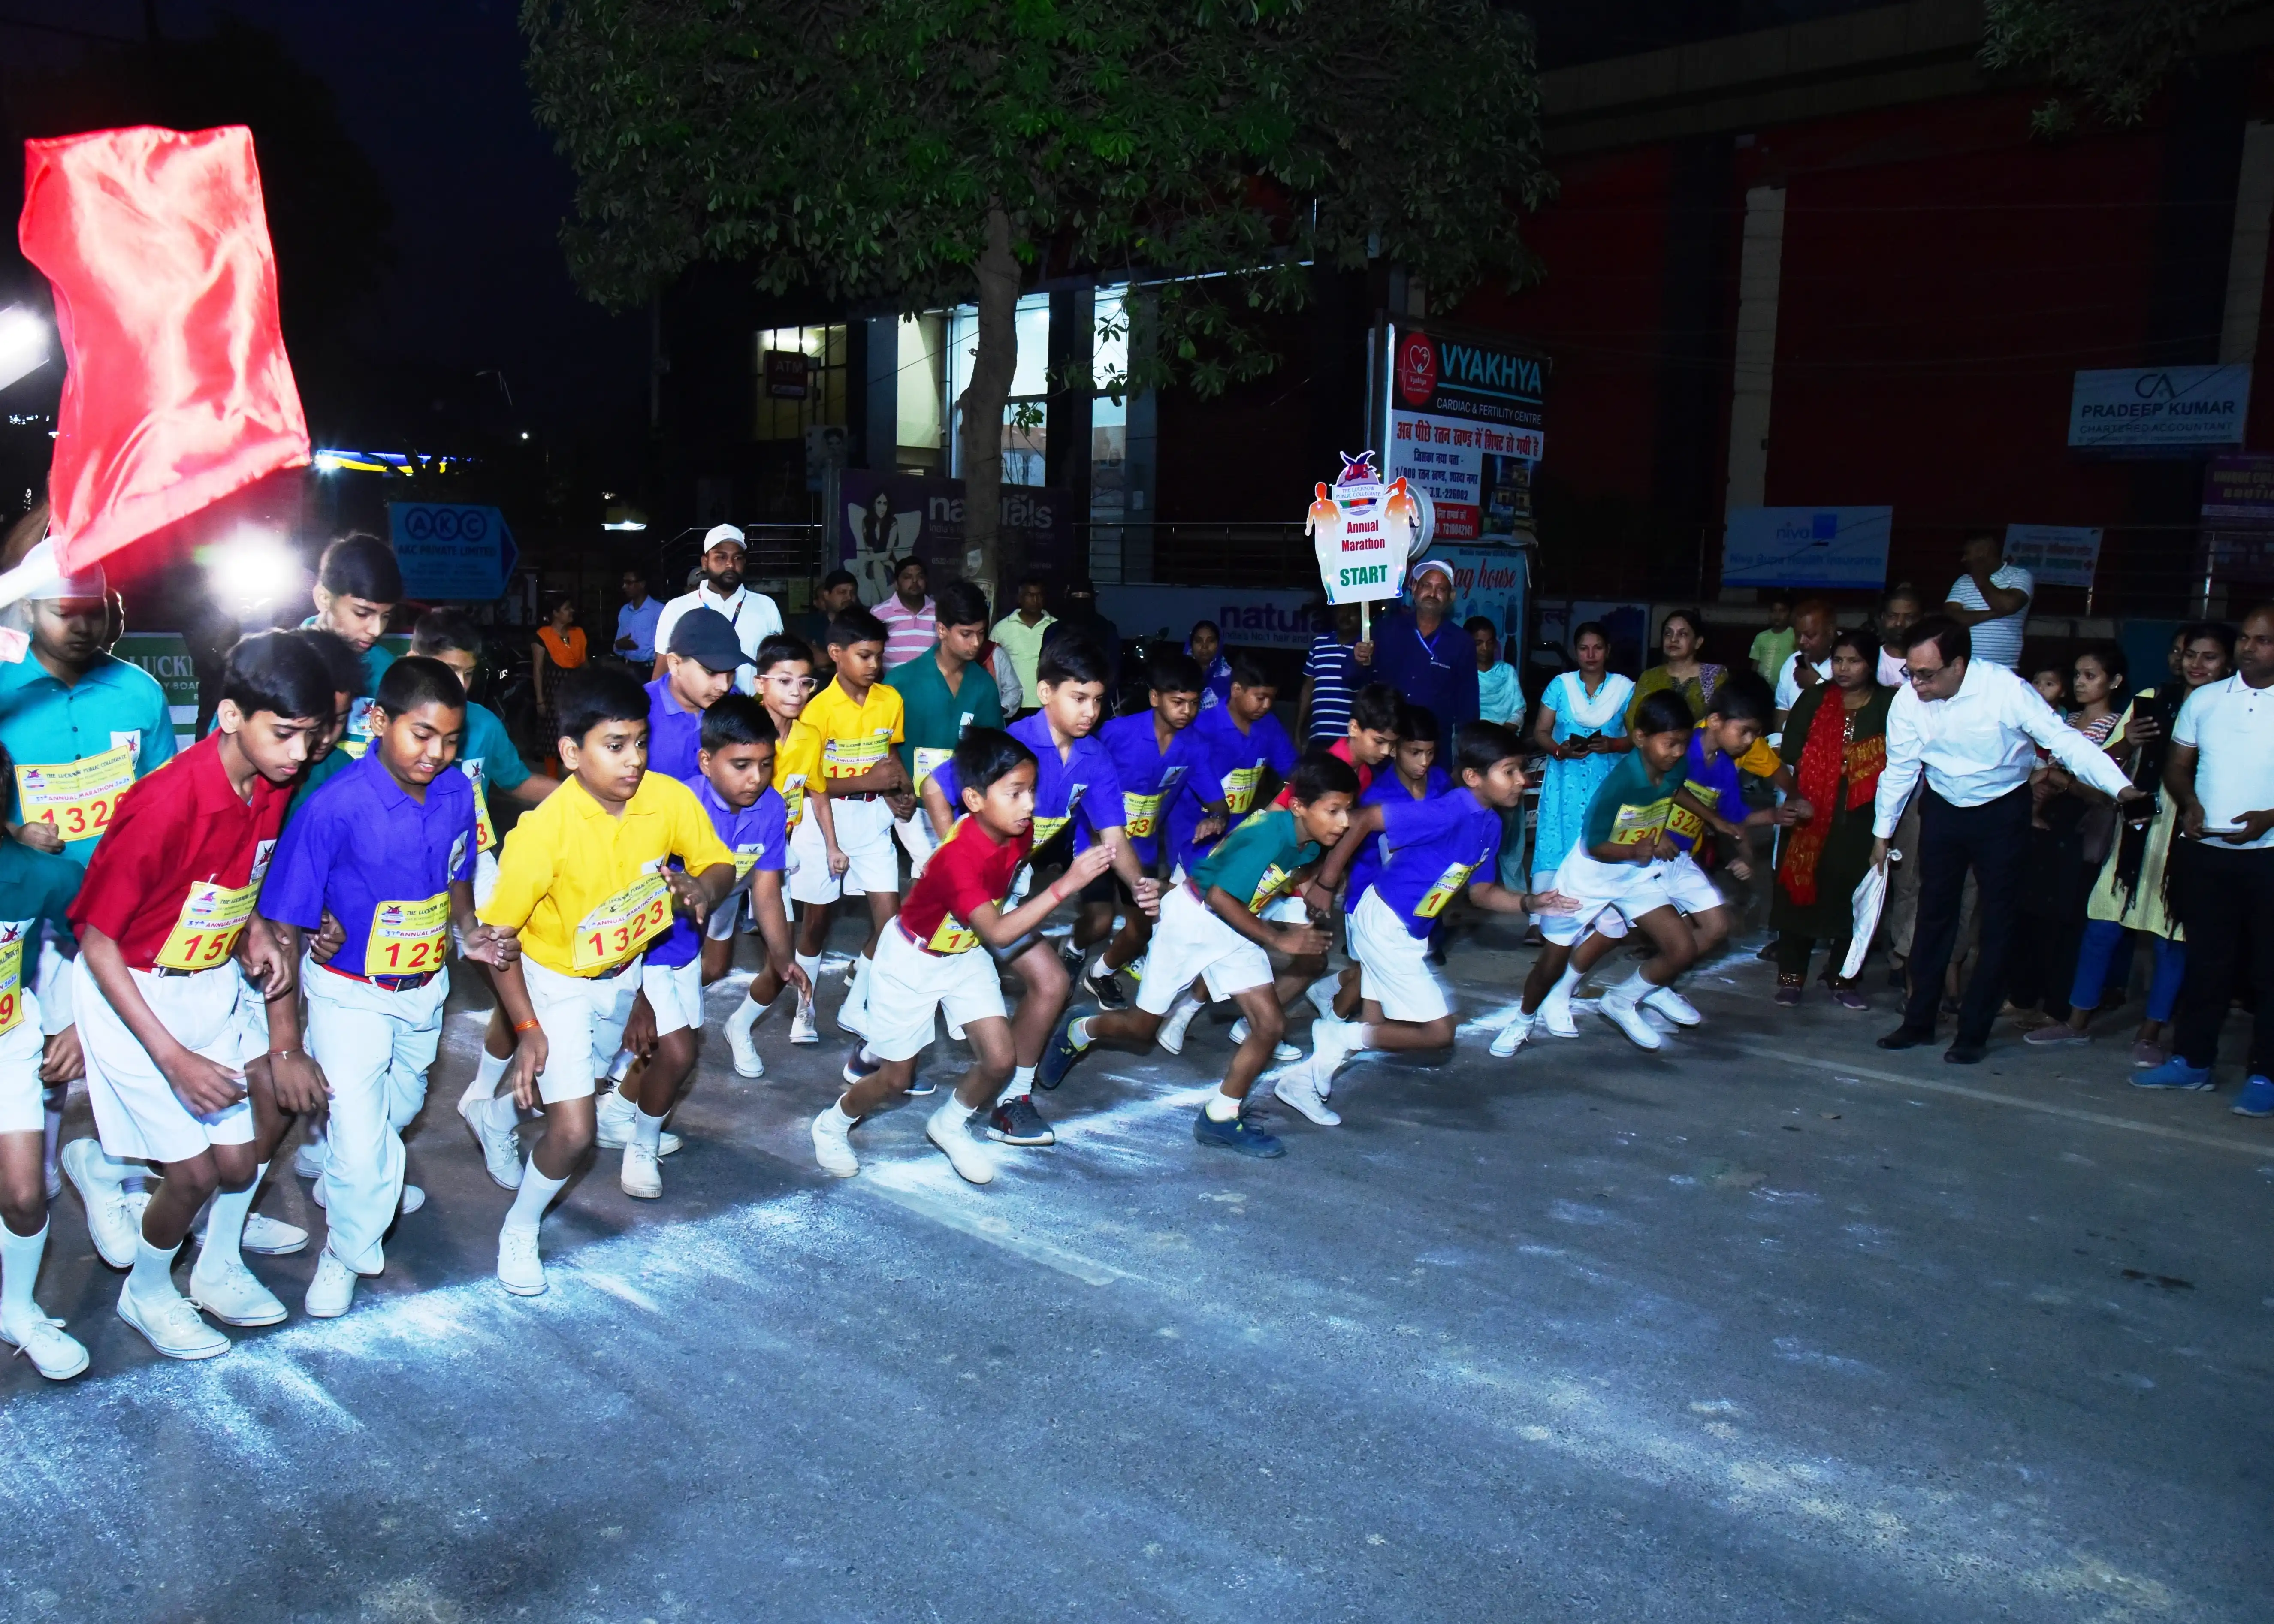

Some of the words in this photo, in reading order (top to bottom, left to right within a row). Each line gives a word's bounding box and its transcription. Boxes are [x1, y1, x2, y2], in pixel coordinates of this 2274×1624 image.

[776, 361, 803, 374] ATM
[1442, 342, 1542, 395] VYAKHYA
[1437, 398, 1471, 413] CARDIAC
[1472, 403, 1477, 414] &
[1479, 404, 1513, 420] FERTILITY
[1514, 411, 1542, 424] CENTRE
[2081, 403, 2164, 417] PRADEEP
[2168, 401, 2235, 416] KUMAR
[1397, 421, 1413, 440] अब
[1415, 420, 1431, 442] पीछे
[1434, 426, 1451, 445] रतन
[1506, 432, 1514, 453] हो
[2080, 424, 2147, 434] CHARTERED
[2148, 422, 2233, 432] ACCOUNTANT
[1414, 448, 1434, 463] जिसका
[1347, 519, 1379, 534] Annual
[1777, 522, 1810, 539] niva
[420, 545, 457, 556] PRIVATE
[460, 546, 497, 557] LIMITED
[1341, 538, 1385, 552] Marathon
[1826, 555, 1882, 565] Insurance
[1340, 564, 1388, 587] START
[1478, 558, 1517, 589] house
[1223, 631, 1248, 640] India's
[1251, 631, 1270, 640] No.1
[1274, 633, 1289, 642] hair
[1292, 635, 1308, 643] and
[83, 764, 99, 773] PUBLIC
[101, 754, 127, 767] COLLEGIATE
[79, 783, 114, 798] MARATHON
[477, 823, 487, 845] 3
[631, 882, 645, 893] PUBLIC
[597, 917, 625, 926] ANNUAL
[626, 895, 653, 918] MARATHON
[1430, 892, 1441, 911] 1
[589, 900, 664, 956] 1323
[385, 935, 446, 968] 125
[0, 993, 13, 1025] 9
